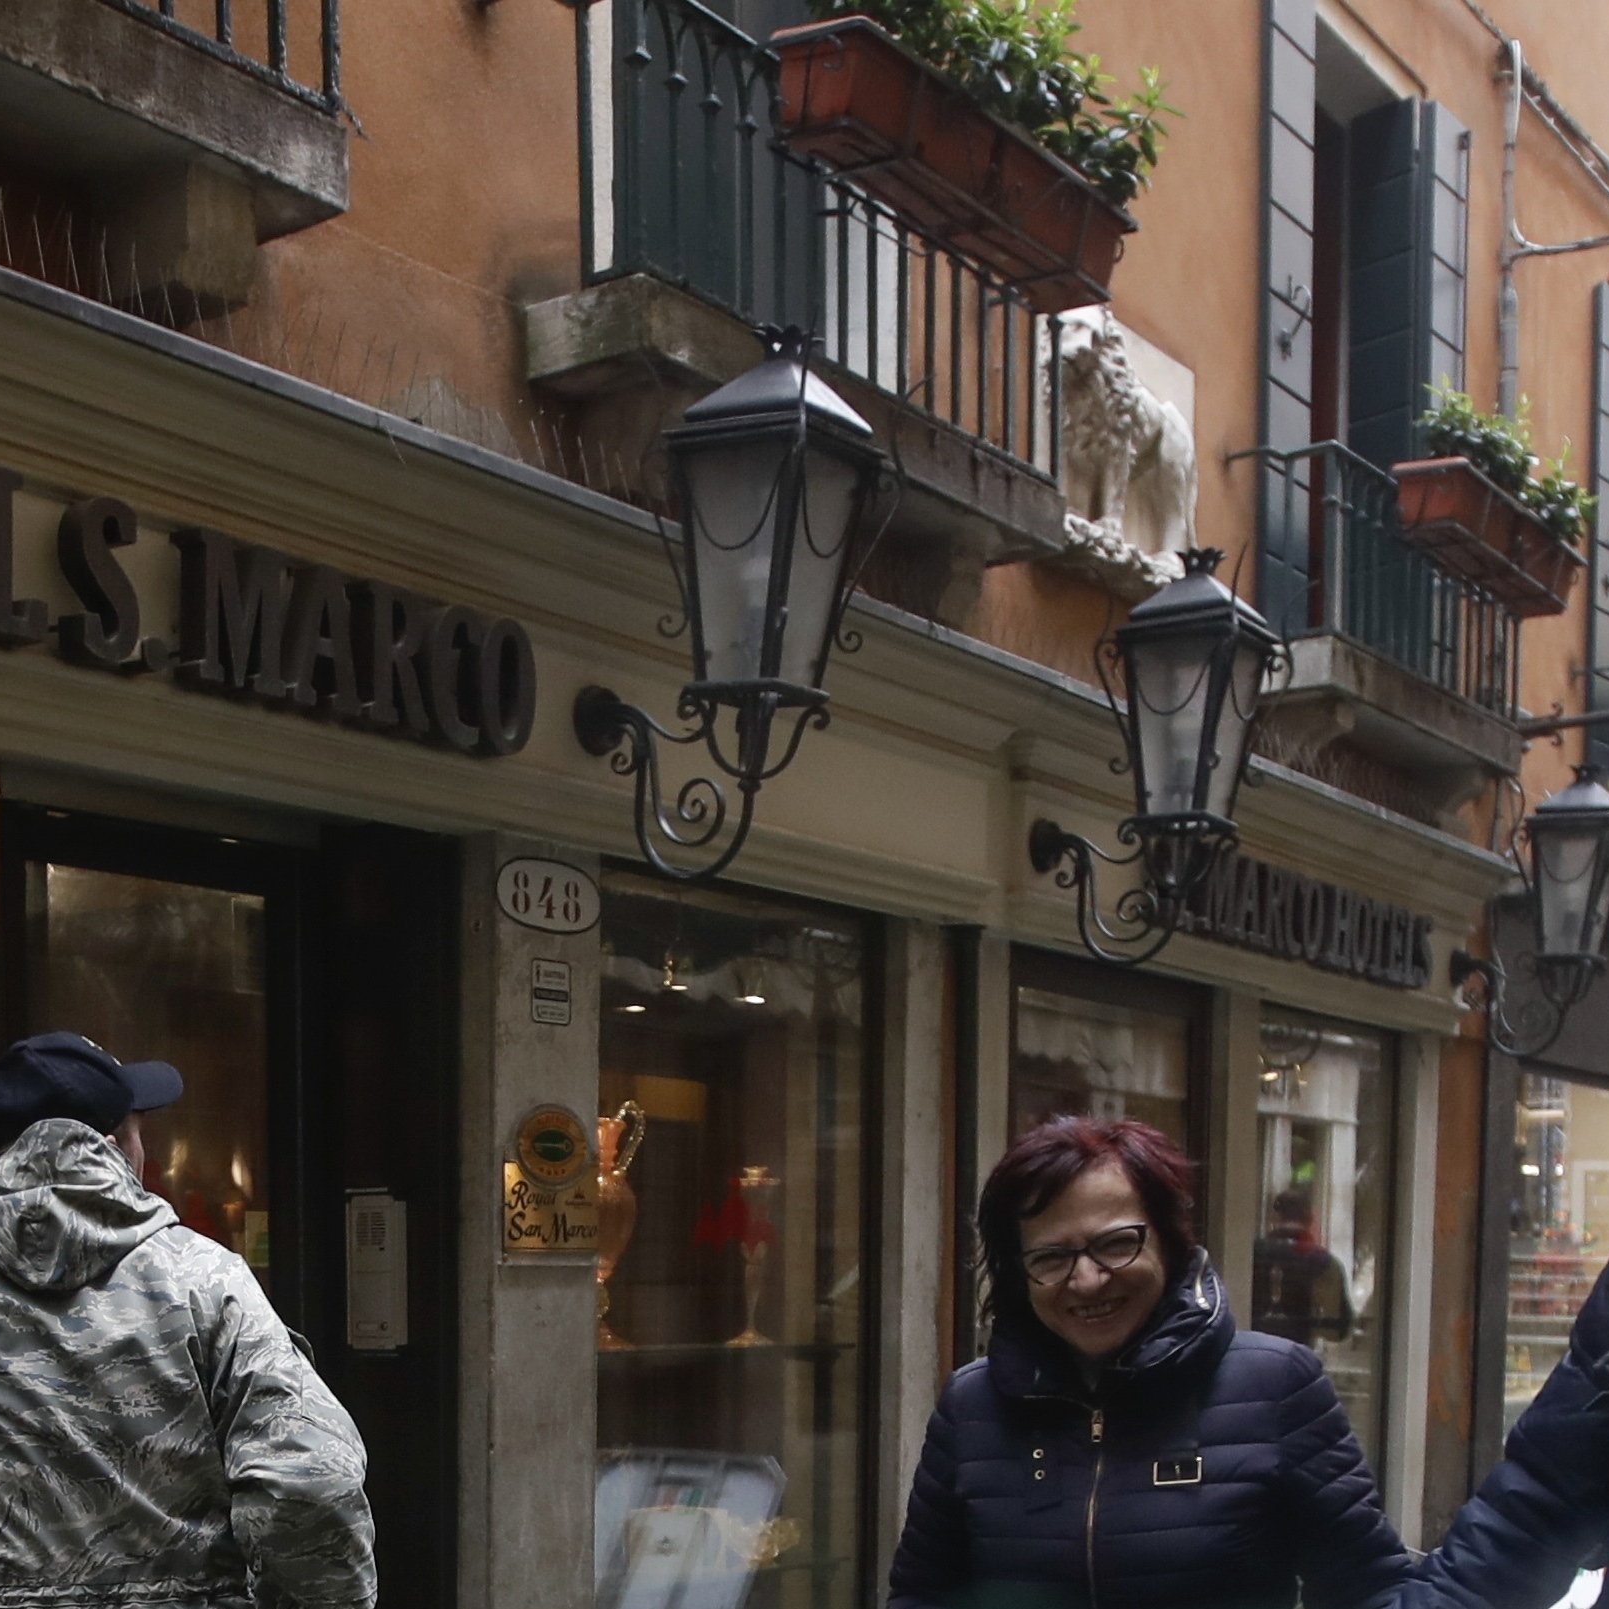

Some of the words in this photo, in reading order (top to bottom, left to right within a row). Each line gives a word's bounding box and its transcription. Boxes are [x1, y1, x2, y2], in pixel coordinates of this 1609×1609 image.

[57, 497, 171, 674] S.
[170, 524, 538, 758] MARCO
[511, 869, 583, 925] 848
[1201, 848, 1327, 962] MARCO
[1319, 885, 1435, 989] HOTELS
[505, 1180, 559, 1212] Royal
[507, 1211, 542, 1242] San
[540, 1212, 599, 1244] Marco
